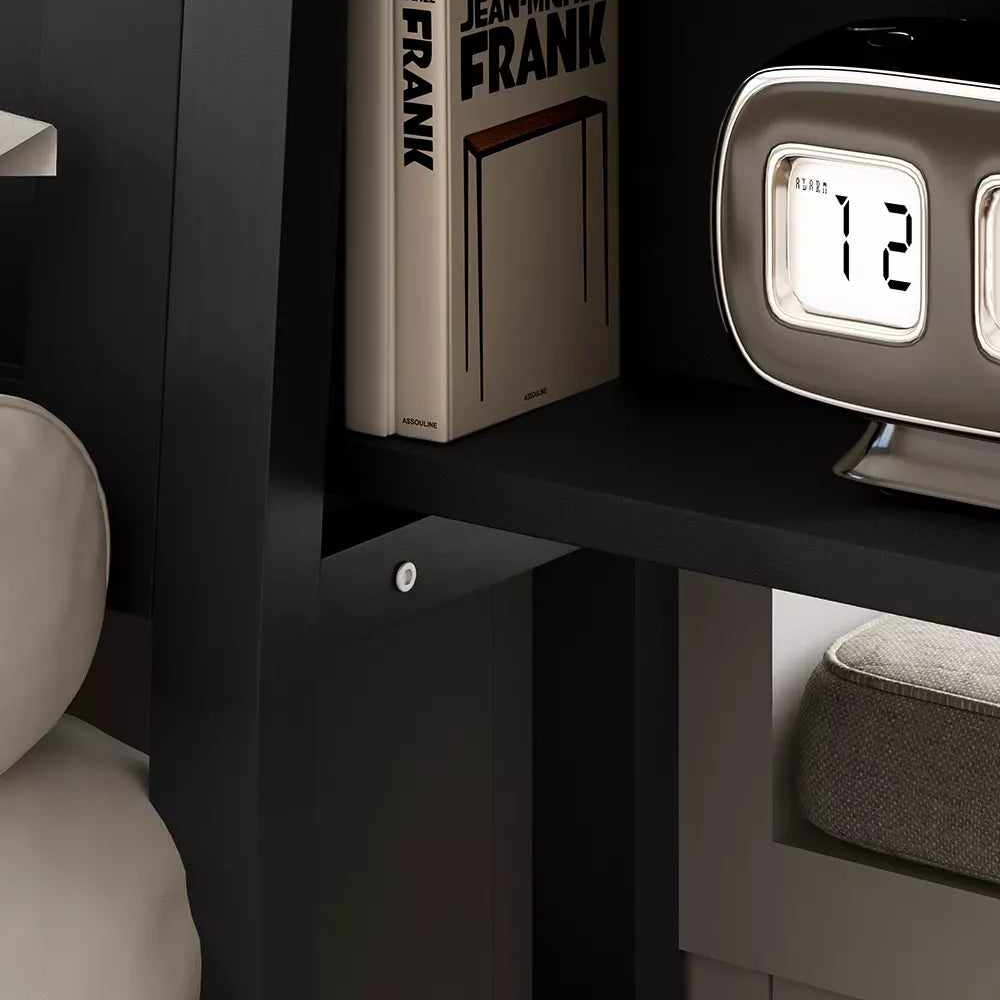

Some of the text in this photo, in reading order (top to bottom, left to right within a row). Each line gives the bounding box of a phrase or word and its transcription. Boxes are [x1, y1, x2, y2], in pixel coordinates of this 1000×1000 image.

[461, 0, 607, 102] FRANK
[402, 7, 434, 171] FRANK
[795, 177, 828, 194] ALARM
[523, 386, 548, 401] ASSOULINE
[402, 417, 438, 429] ASSOULINE
